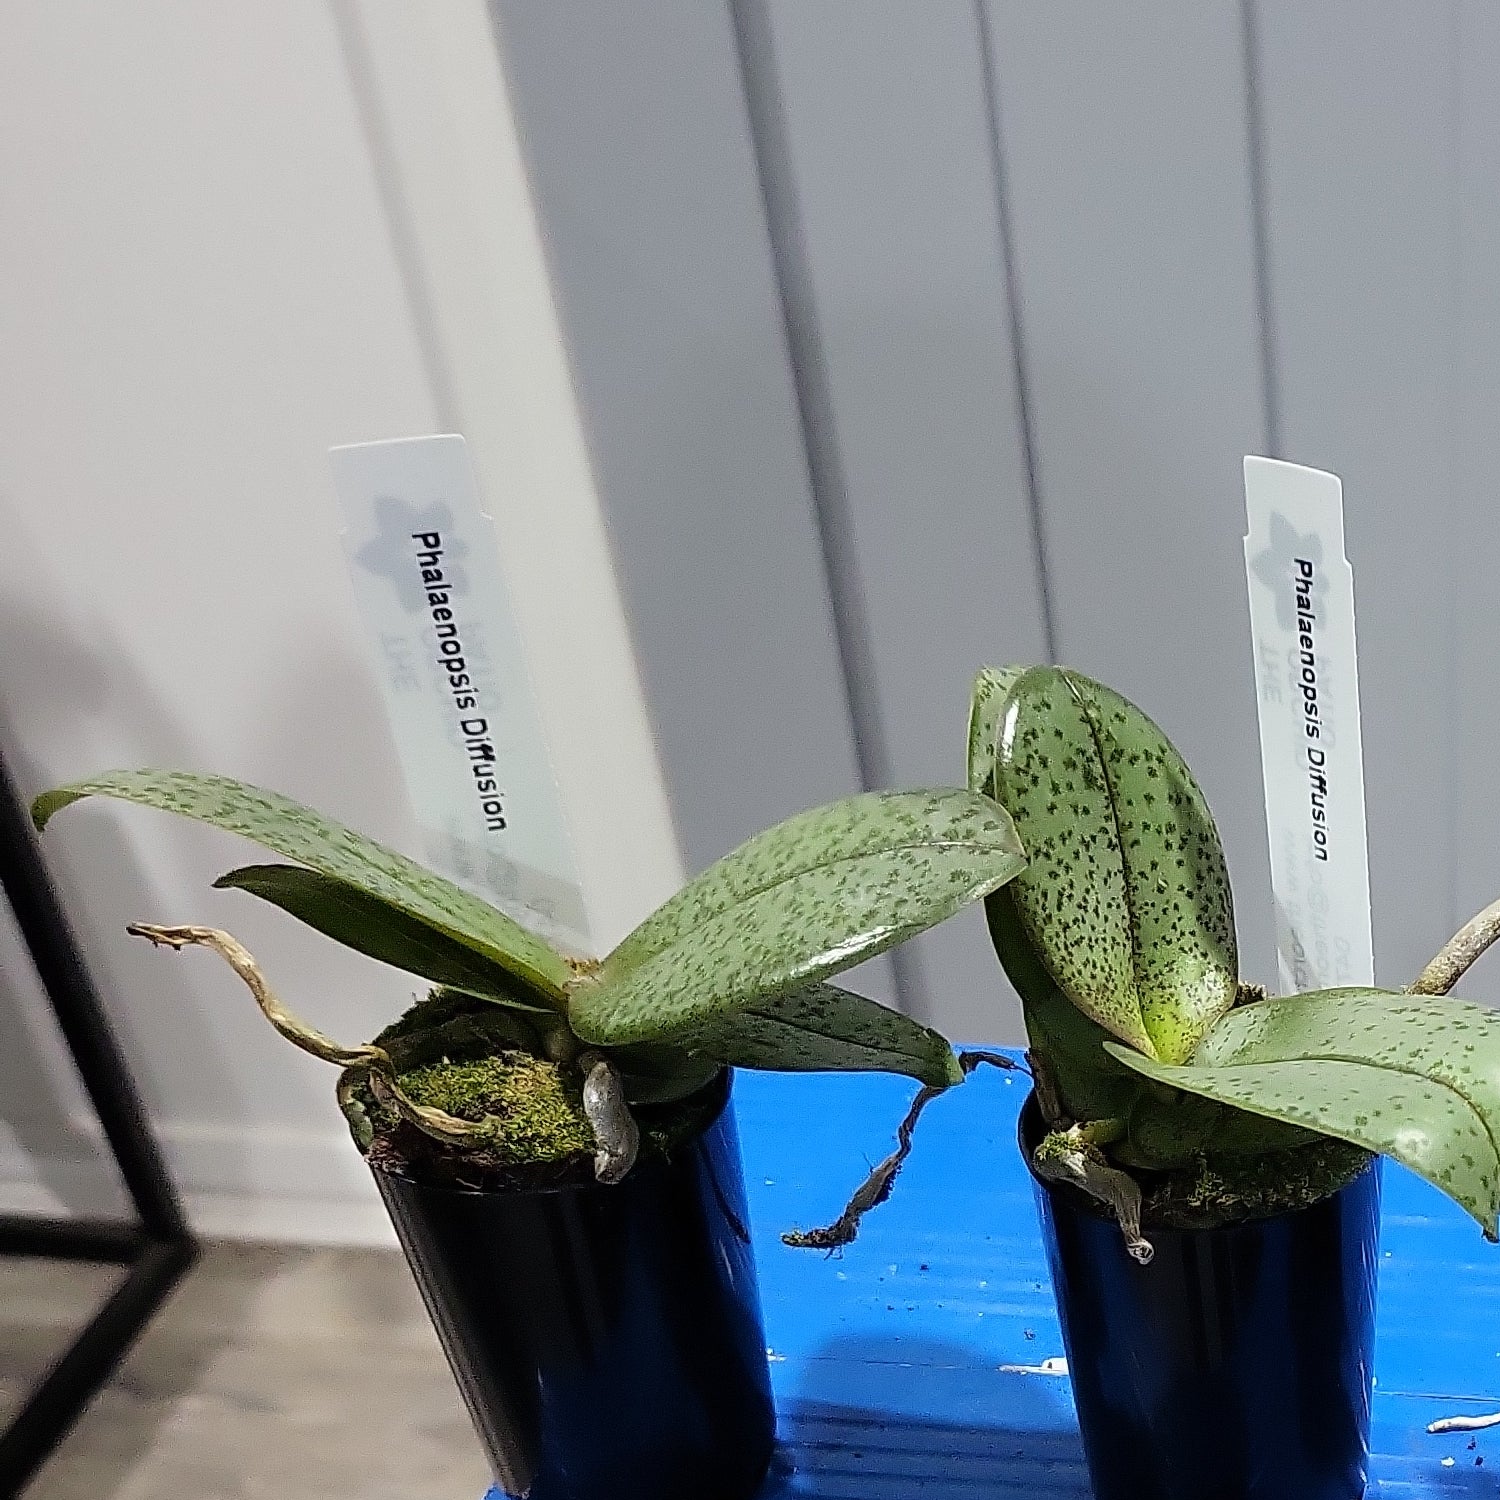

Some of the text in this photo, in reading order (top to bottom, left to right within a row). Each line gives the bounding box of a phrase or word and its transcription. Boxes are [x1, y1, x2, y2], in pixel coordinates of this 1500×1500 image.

[412, 531, 507, 832] Phalaenopsis Diffusion
[1293, 556, 1329, 861] Phalaenopsis Diffusion
